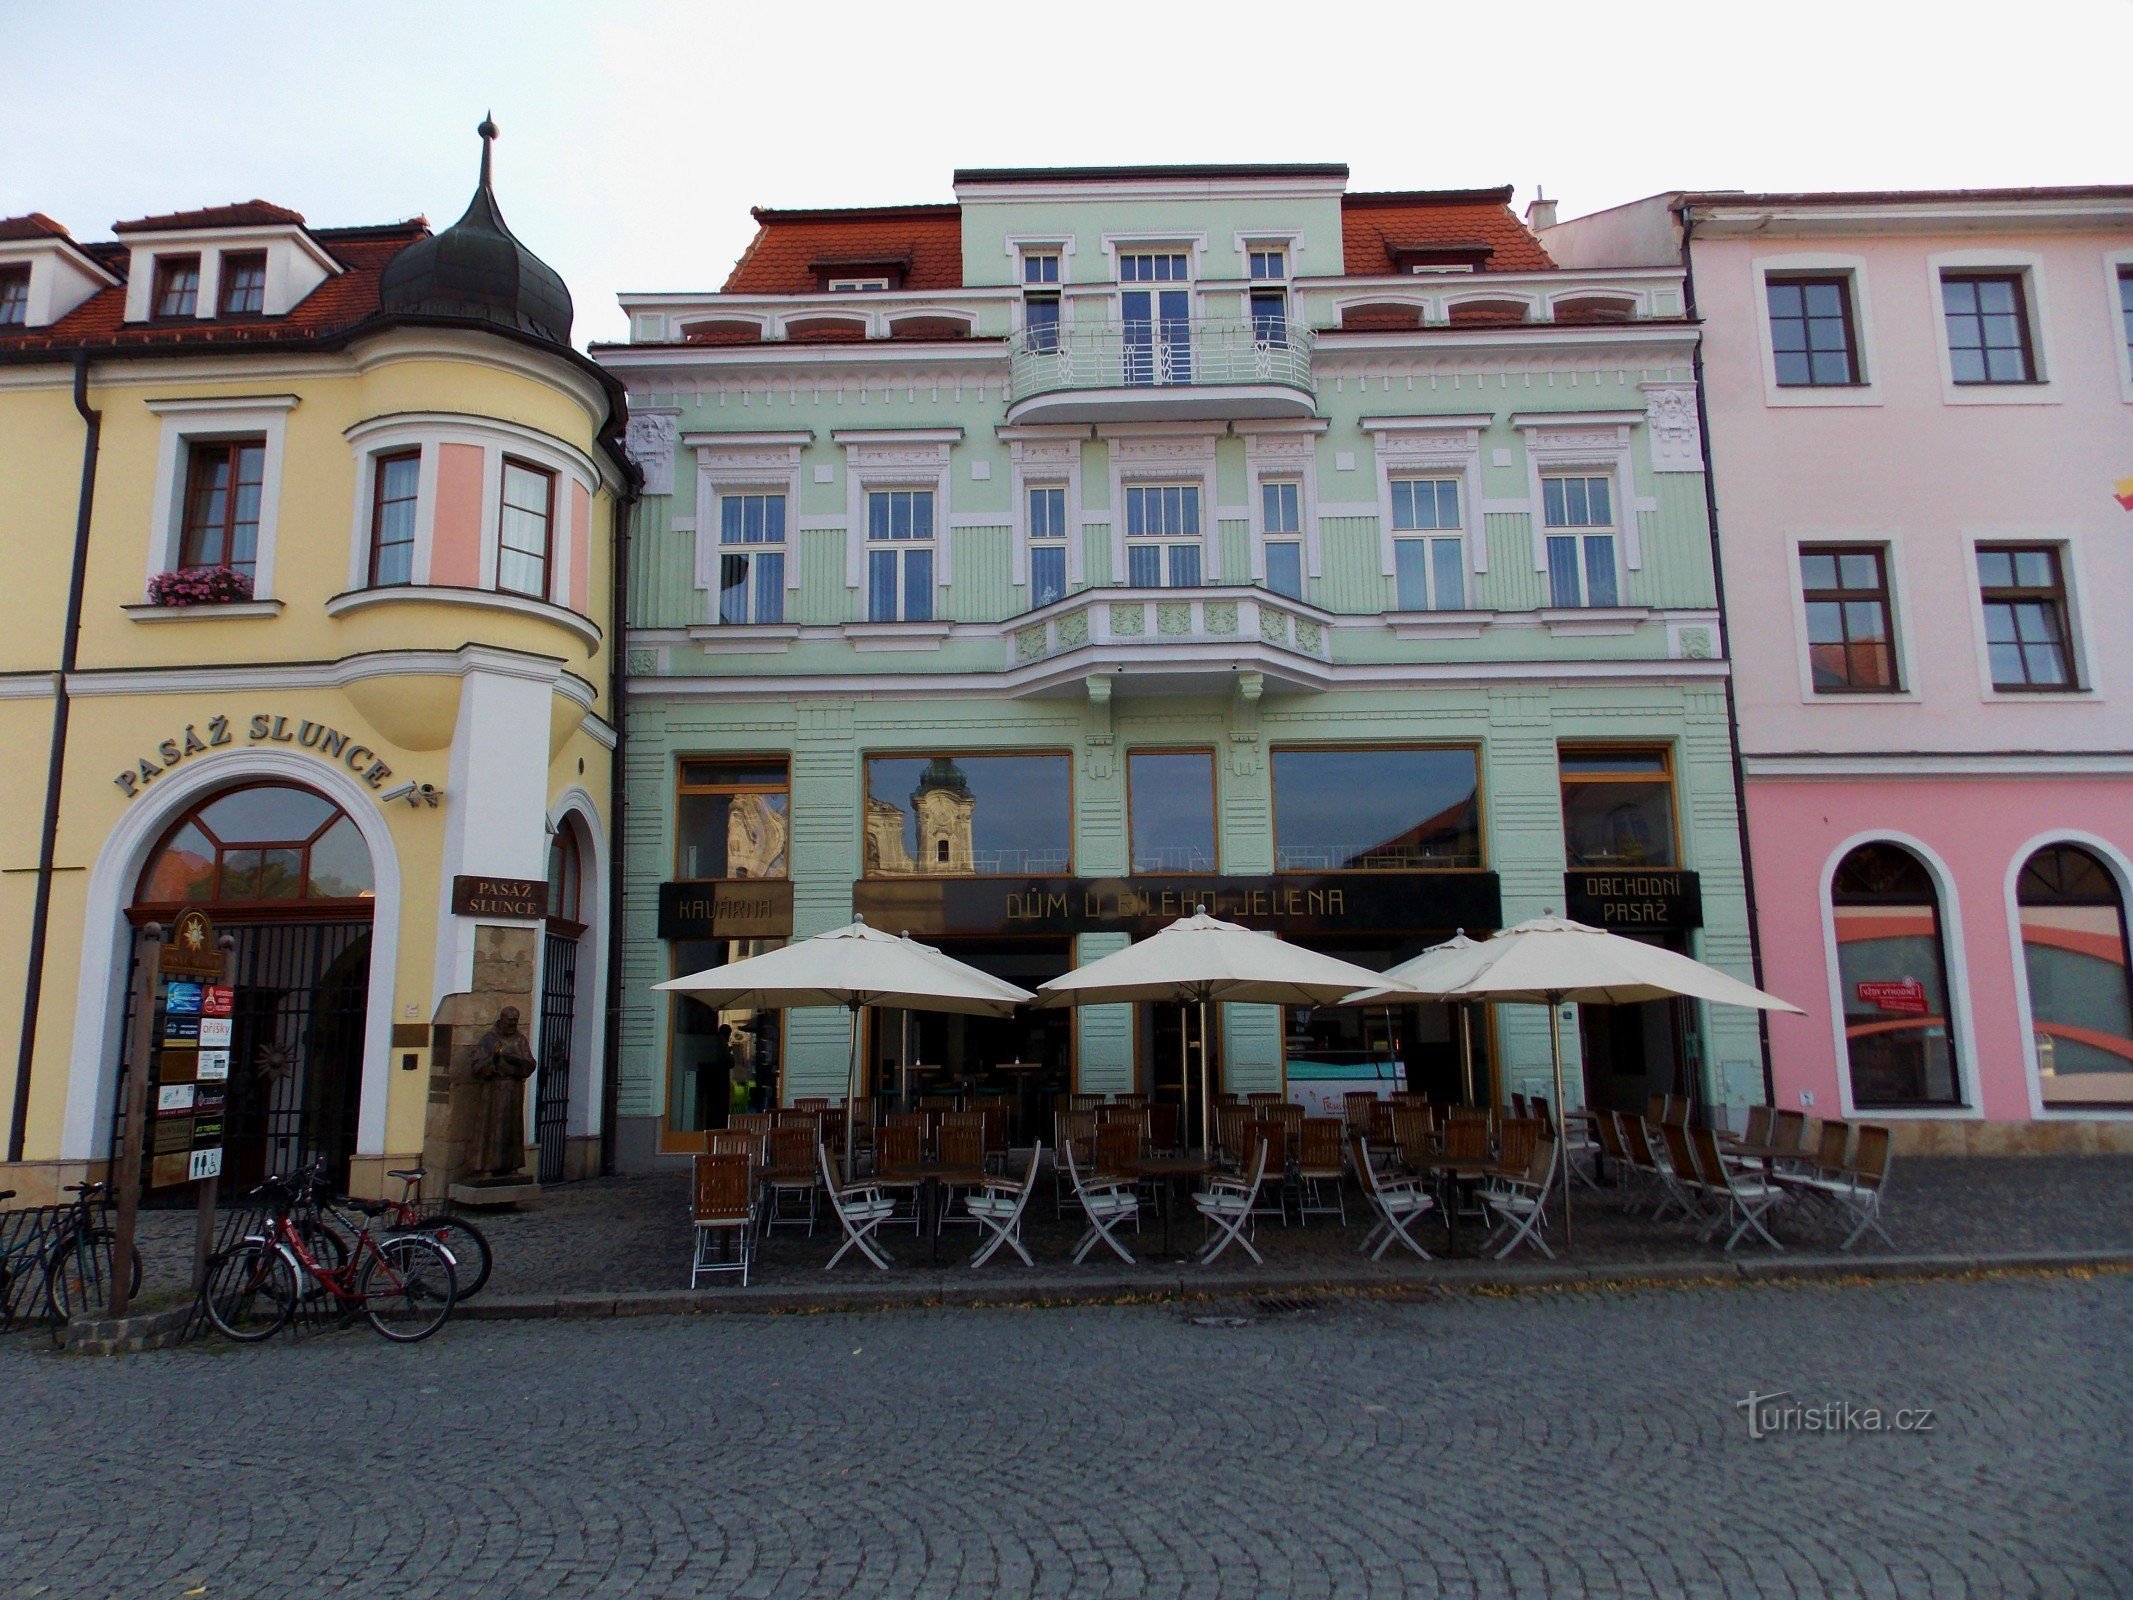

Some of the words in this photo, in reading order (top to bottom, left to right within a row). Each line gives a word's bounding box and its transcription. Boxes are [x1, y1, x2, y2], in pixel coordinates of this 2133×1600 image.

[113, 715, 232, 798] PASÁŽ
[249, 714, 392, 789] SLUNCE
[479, 882, 532, 898] PASÁŽ
[1586, 874, 1681, 896] OBCHODNÍ
[469, 898, 537, 915] SLUNCE
[680, 896, 772, 919] KAVÁRNA
[1006, 887, 1068, 918] DŮM
[1085, 892, 1101, 918] U
[1118, 885, 1217, 917] BÍLÉHO
[1233, 889, 1344, 916] JELENA
[1603, 898, 1668, 921] PASÁŽ
